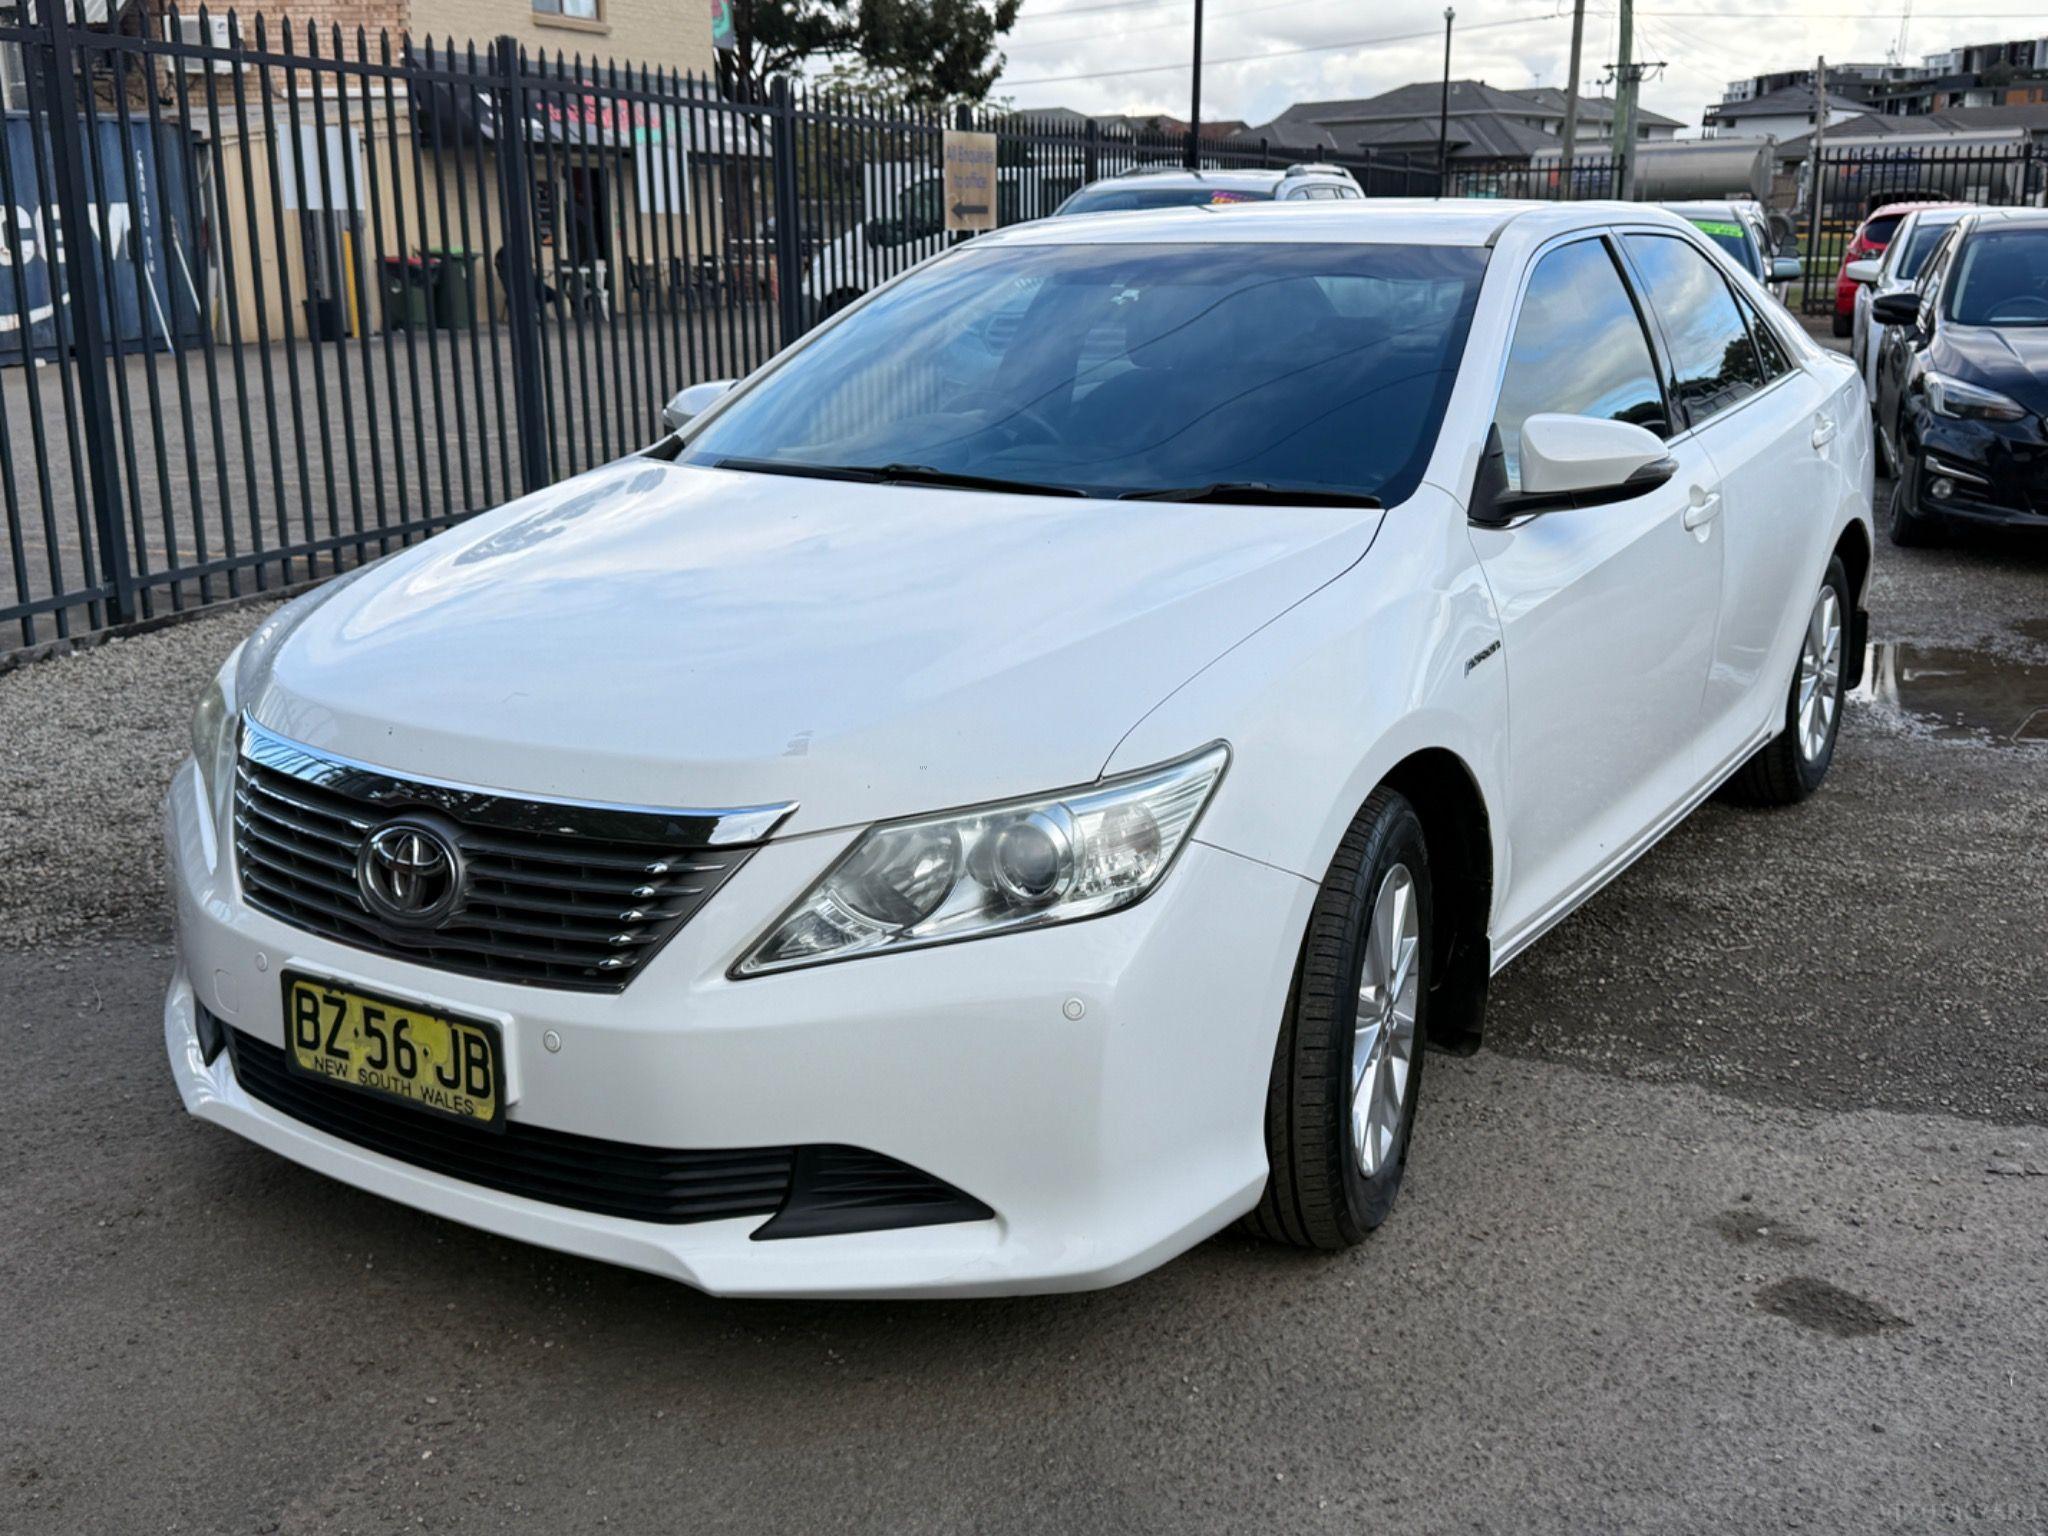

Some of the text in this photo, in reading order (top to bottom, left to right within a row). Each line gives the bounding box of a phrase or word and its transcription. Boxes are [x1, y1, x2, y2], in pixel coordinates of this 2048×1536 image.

[313, 1056, 475, 1115] NEW SOUTH WALES
